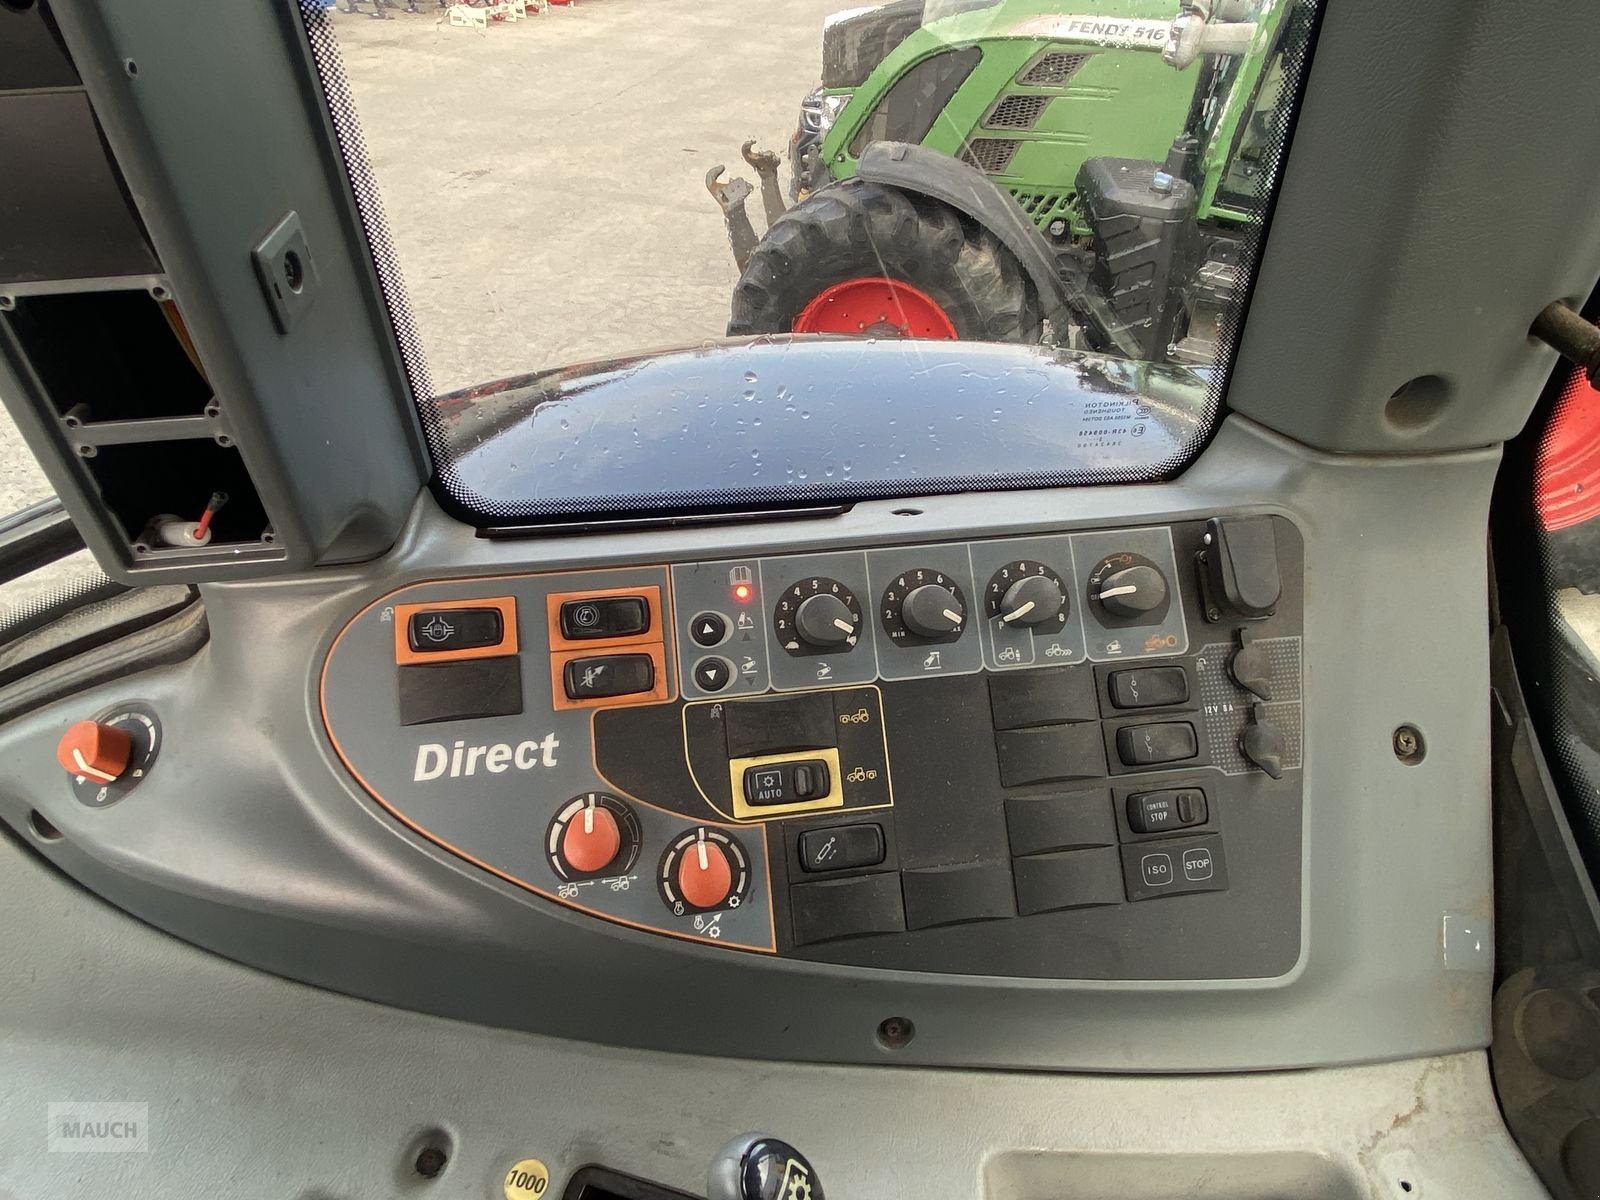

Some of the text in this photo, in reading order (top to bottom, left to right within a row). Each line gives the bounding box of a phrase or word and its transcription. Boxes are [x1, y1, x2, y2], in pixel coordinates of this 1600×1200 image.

[1133, 26, 1165, 40] 516
[1019, 563, 1026, 572] 4
[1038, 566, 1044, 575] 5
[917, 571, 923, 580] 5
[1002, 569, 1008, 578] 3
[898, 577, 905, 587] 4
[937, 574, 943, 584] 6
[949, 586, 955, 595] 7
[992, 583, 999, 592] 2
[888, 591, 895, 601] 3
[1060, 595, 1066, 604] 7
[778, 580, 859, 629] 2 3 4 5 6 7 8
[991, 601, 996, 610] 1
[885, 610, 893, 619] 2
[1058, 613, 1065, 622] 8
[999, 621, 1004, 630] P
[1204, 705, 1218, 714] 12V
[413, 732, 560, 782] Direct
[758, 788, 783, 800] AUTO
[1146, 801, 1169, 811] CONTROL
[1150, 811, 1168, 823] STOP
[1185, 858, 1210, 870] STOP
[1148, 864, 1167, 875] ISO
[510, 1168, 547, 1194] 1000
